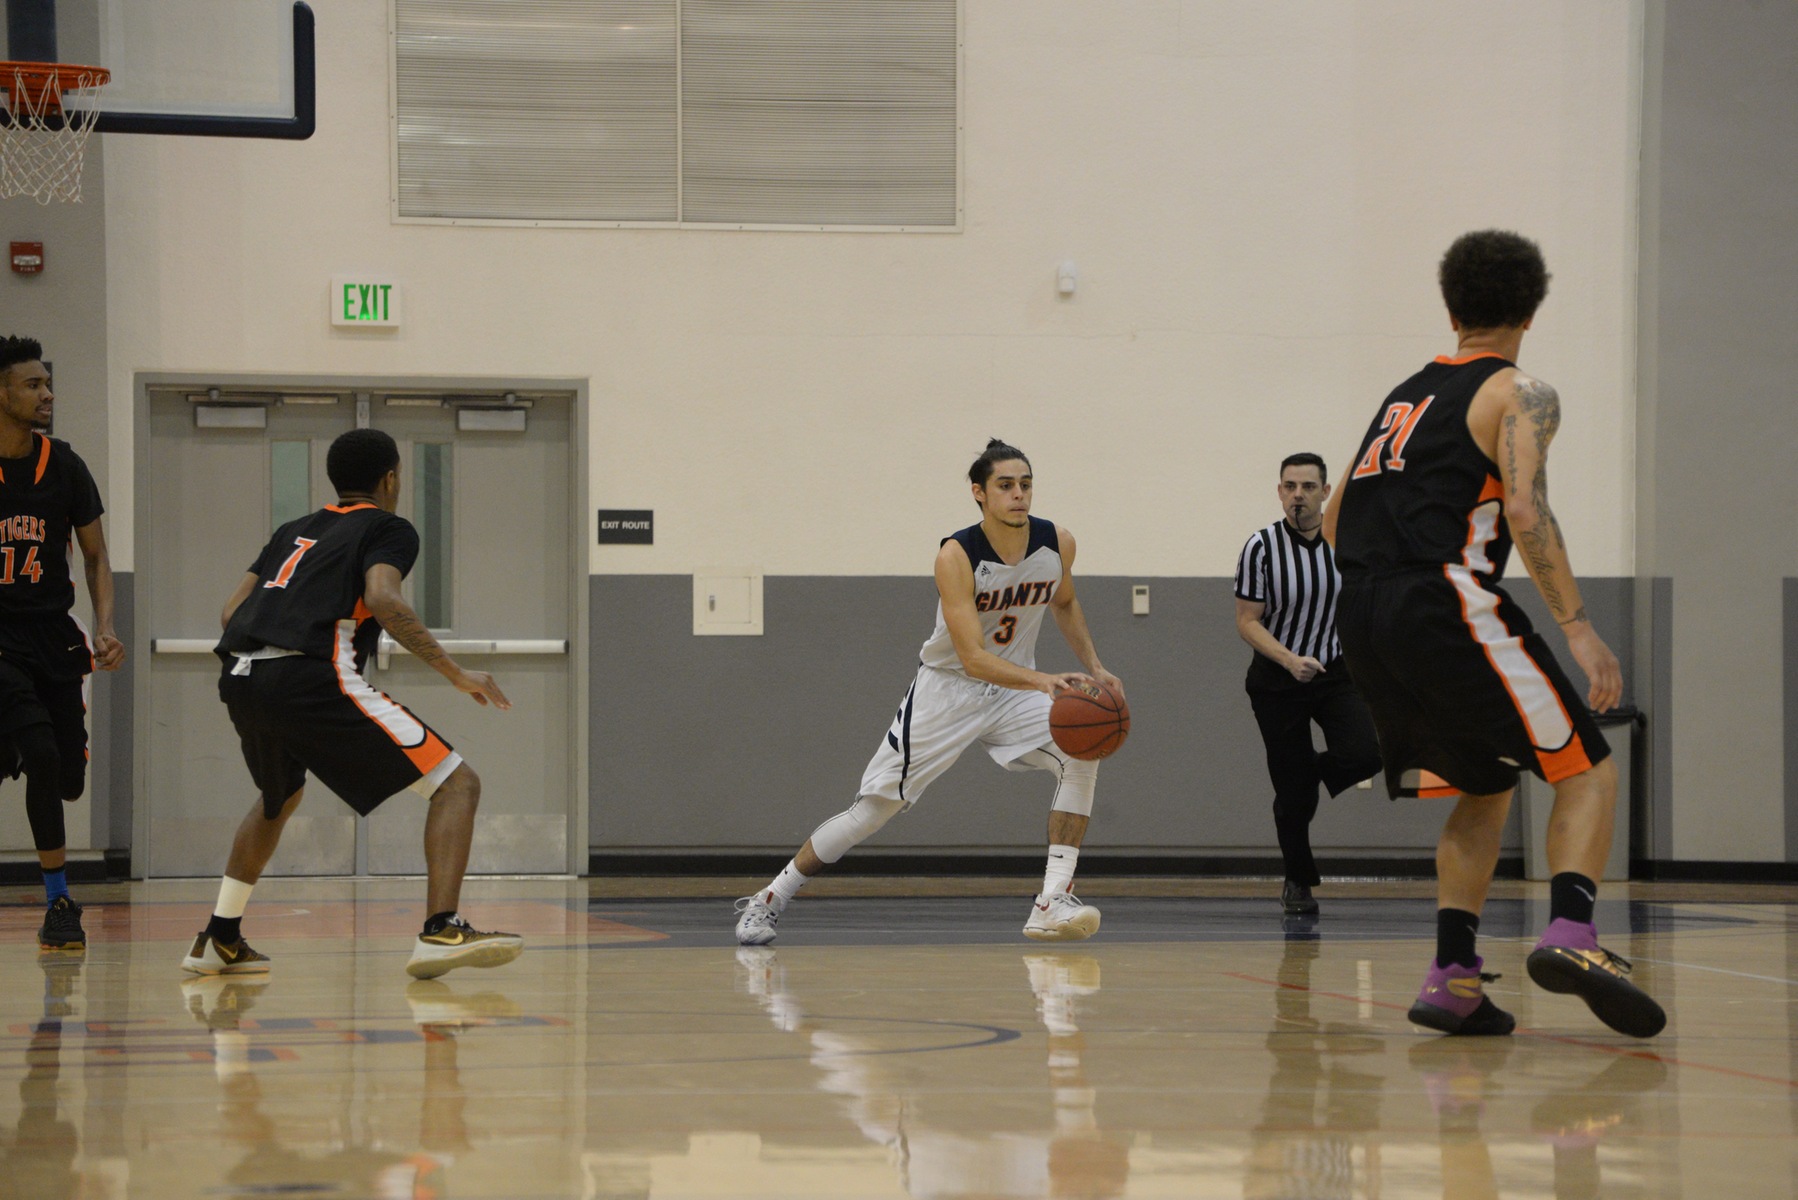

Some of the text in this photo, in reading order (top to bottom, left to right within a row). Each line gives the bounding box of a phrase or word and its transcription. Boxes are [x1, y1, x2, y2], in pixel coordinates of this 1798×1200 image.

[343, 283, 392, 320] EXIT
[1352, 395, 1436, 480] 21
[0, 515, 46, 544] TIGERS
[601, 521, 650, 529] EXIT ROUTE
[0, 546, 43, 584] 14
[263, 536, 318, 589] 1
[974, 579, 1057, 612] GIANTS
[992, 614, 1018, 646] 3
